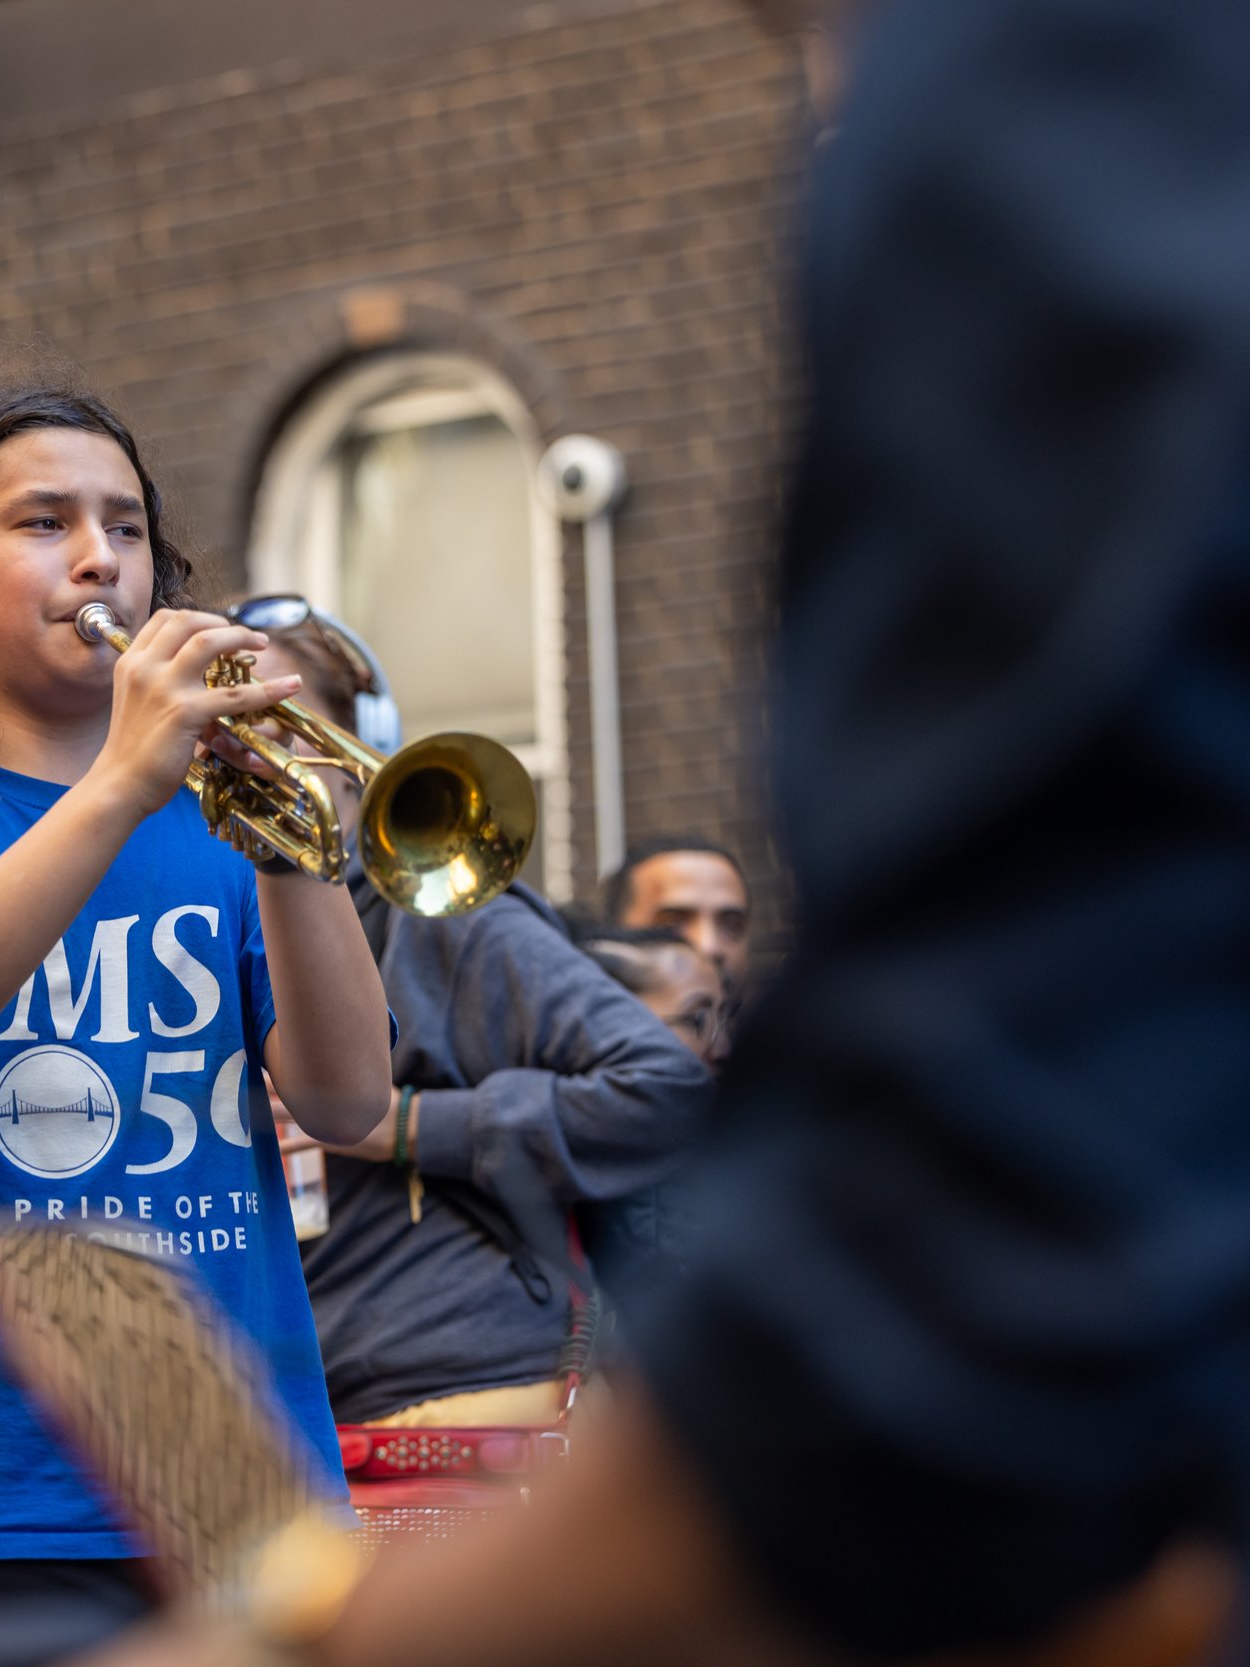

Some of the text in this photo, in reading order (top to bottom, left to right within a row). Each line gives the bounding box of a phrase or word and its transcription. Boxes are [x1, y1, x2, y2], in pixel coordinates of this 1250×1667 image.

[14, 1190, 259, 1222] PRIDE OF THE
